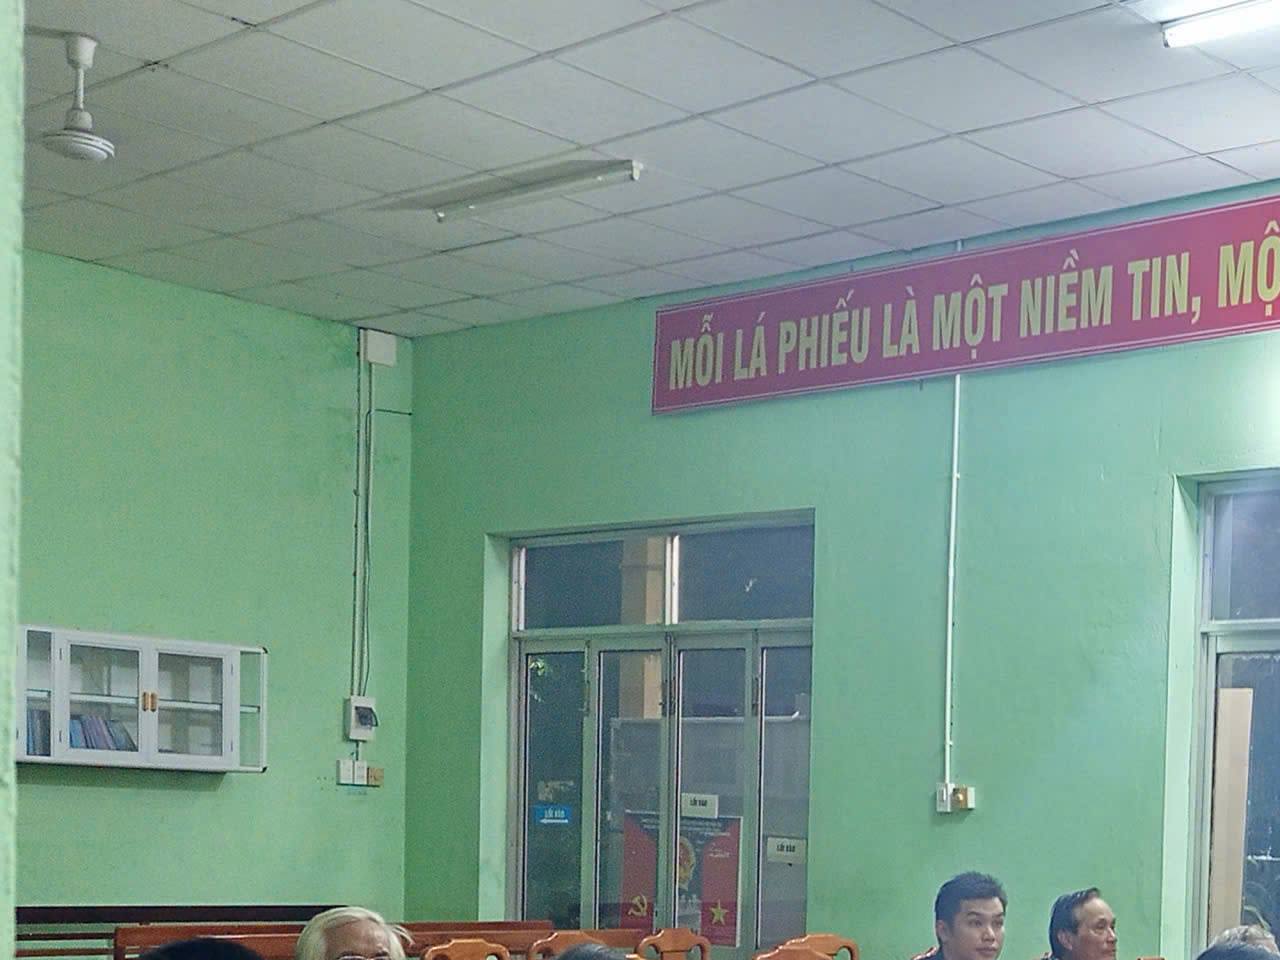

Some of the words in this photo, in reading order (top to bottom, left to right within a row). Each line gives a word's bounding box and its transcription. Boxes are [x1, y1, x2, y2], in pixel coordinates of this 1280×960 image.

[668, 312, 725, 391] MỖI
[733, 311, 768, 381] LÁ
[777, 289, 872, 375] PHIẾU
[882, 285, 920, 359] LÀ
[931, 273, 1009, 360] MỘT
[1018, 249, 1114, 338] NIỀM
[1127, 251, 1201, 325] TIN,
